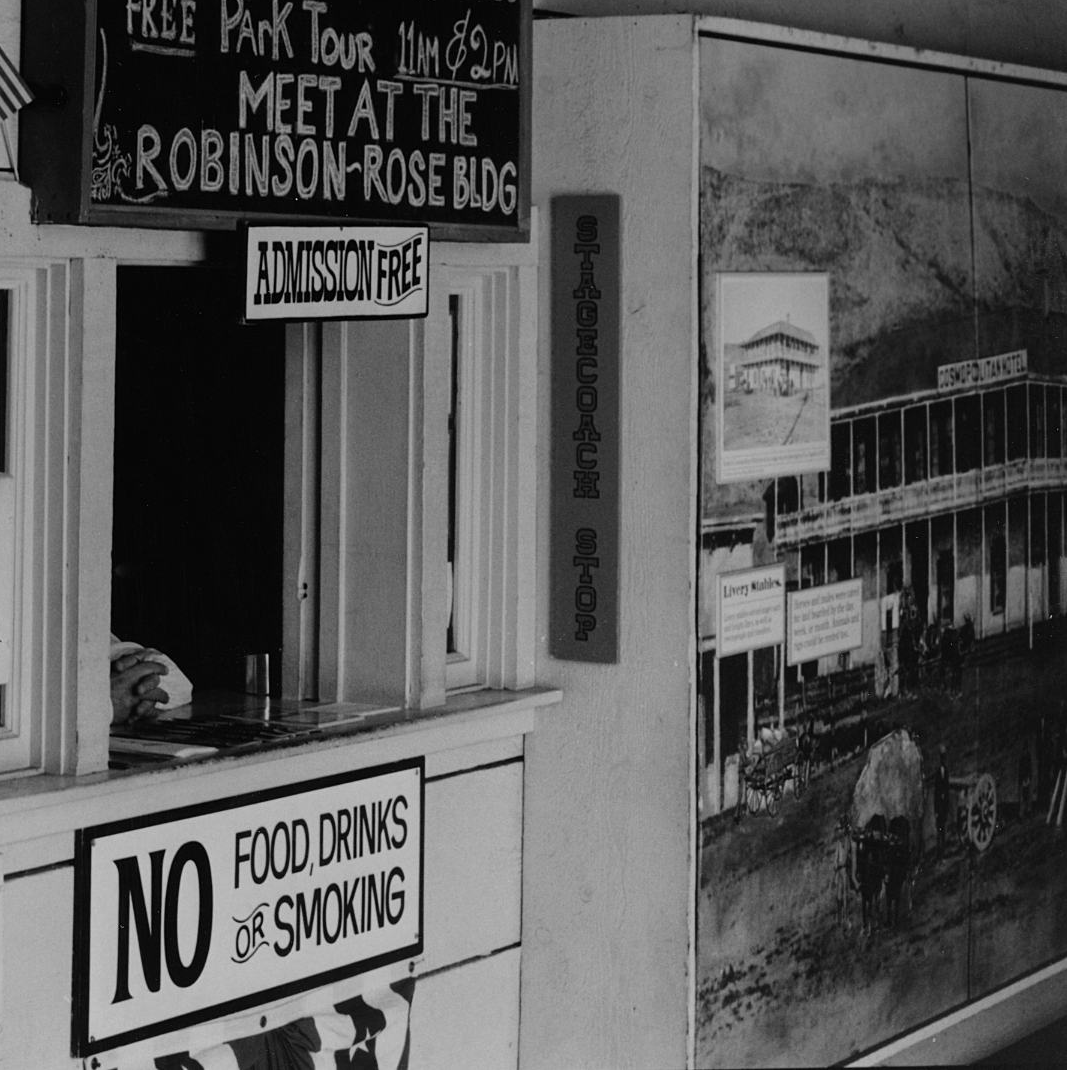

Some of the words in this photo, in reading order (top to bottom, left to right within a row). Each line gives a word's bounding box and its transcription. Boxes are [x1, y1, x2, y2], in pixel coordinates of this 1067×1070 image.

[445, 8, 472, 80] &
[470, 23, 519, 84] 2PM
[239, 70, 342, 138] MEET
[347, 77, 404, 142] AT
[413, 83, 478, 147] THE
[453, 156, 518, 216] BLDG
[253, 238, 375, 306] ADMISSION
[376, 236, 422, 302] FREE
[573, 215, 601, 500] STAGECOACH
[939, 358, 1007, 389] COSMOPOLITAN
[1006, 352, 1026, 376] HOTEL
[573, 527, 600, 642] STOP
[723, 583, 749, 599] Livery
[110, 840, 214, 1005] NO
[234, 818, 315, 890] FOOD,
[318, 795, 409, 868] DRINKS
[235, 911, 265, 959] OR
[273, 866, 406, 958] SMOKING
